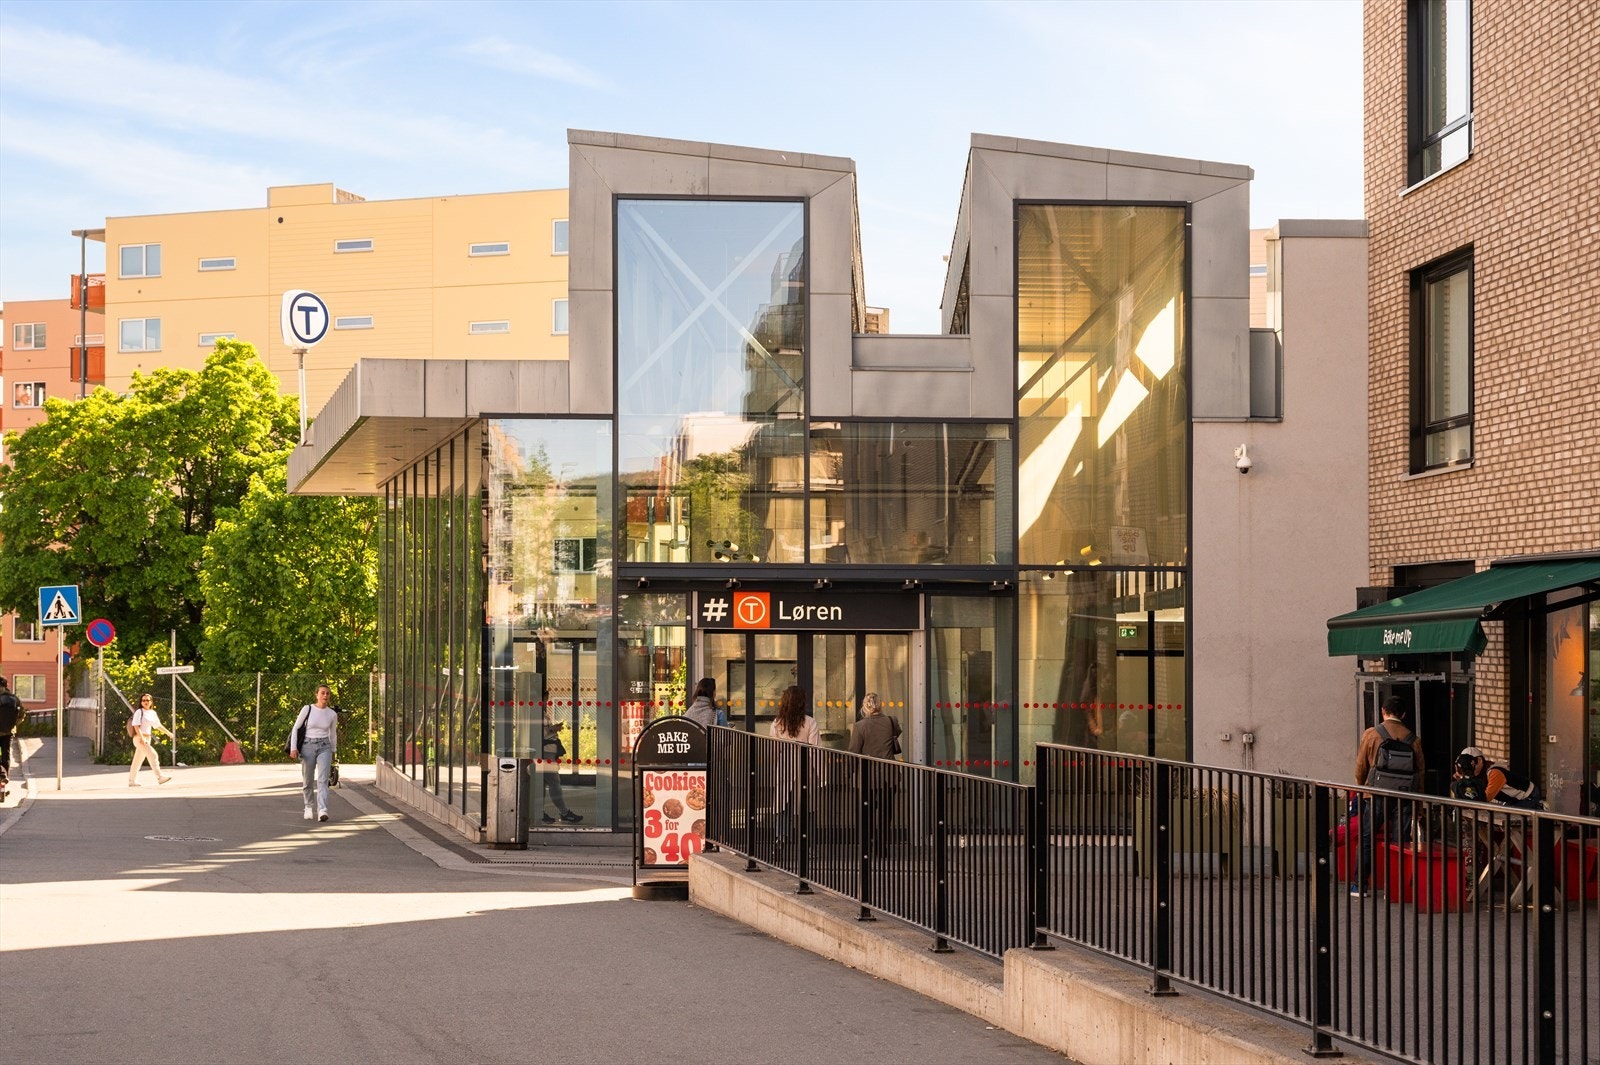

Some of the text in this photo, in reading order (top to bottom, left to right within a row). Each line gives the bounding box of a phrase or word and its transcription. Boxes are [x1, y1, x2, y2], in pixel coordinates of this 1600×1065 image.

[297, 305, 318, 335] T
[779, 600, 842, 621] Løren
[658, 731, 689, 743] BAKE
[657, 743, 691, 754] ME UP
[645, 772, 706, 791] Cookies
[645, 809, 680, 839] 3 for
